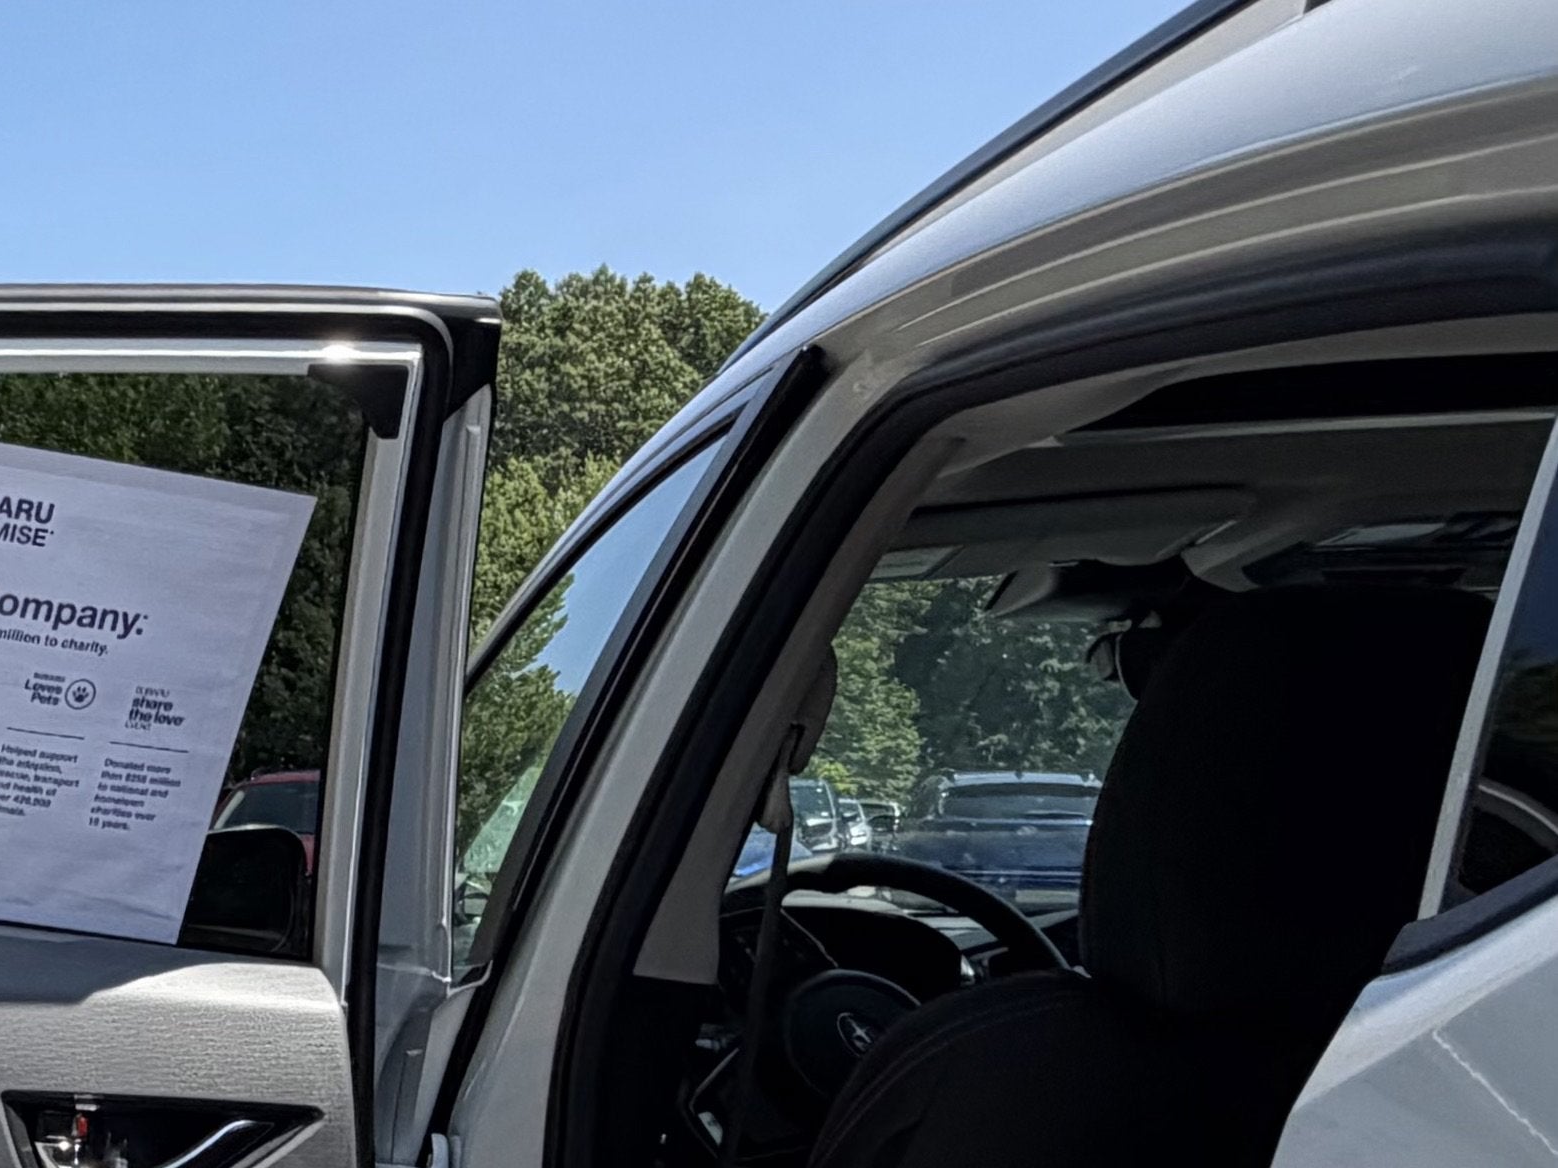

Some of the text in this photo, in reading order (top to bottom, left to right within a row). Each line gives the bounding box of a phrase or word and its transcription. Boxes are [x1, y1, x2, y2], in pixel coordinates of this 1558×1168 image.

[44, 636, 58, 648] to
[61, 639, 109, 657] charity.
[24, 678, 63, 695] Loves
[30, 691, 60, 706] Pets
[132, 697, 173, 712] share
[129, 708, 184, 726] the love
